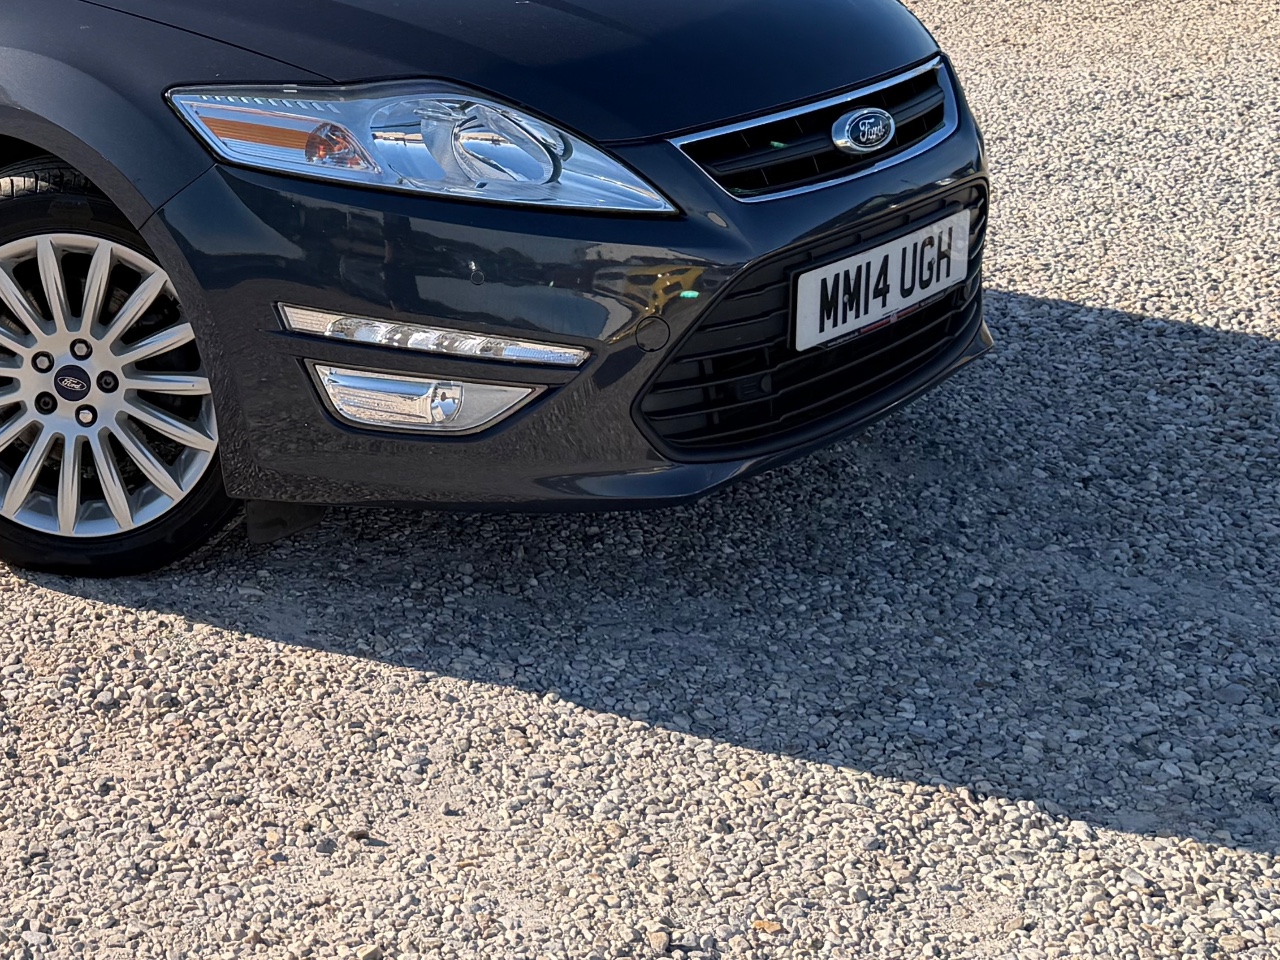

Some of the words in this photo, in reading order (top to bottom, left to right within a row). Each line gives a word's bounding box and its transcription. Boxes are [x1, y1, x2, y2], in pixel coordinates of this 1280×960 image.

[859, 118, 885, 142] Ford
[818, 254, 890, 334] MM14
[899, 226, 954, 299] UGH
